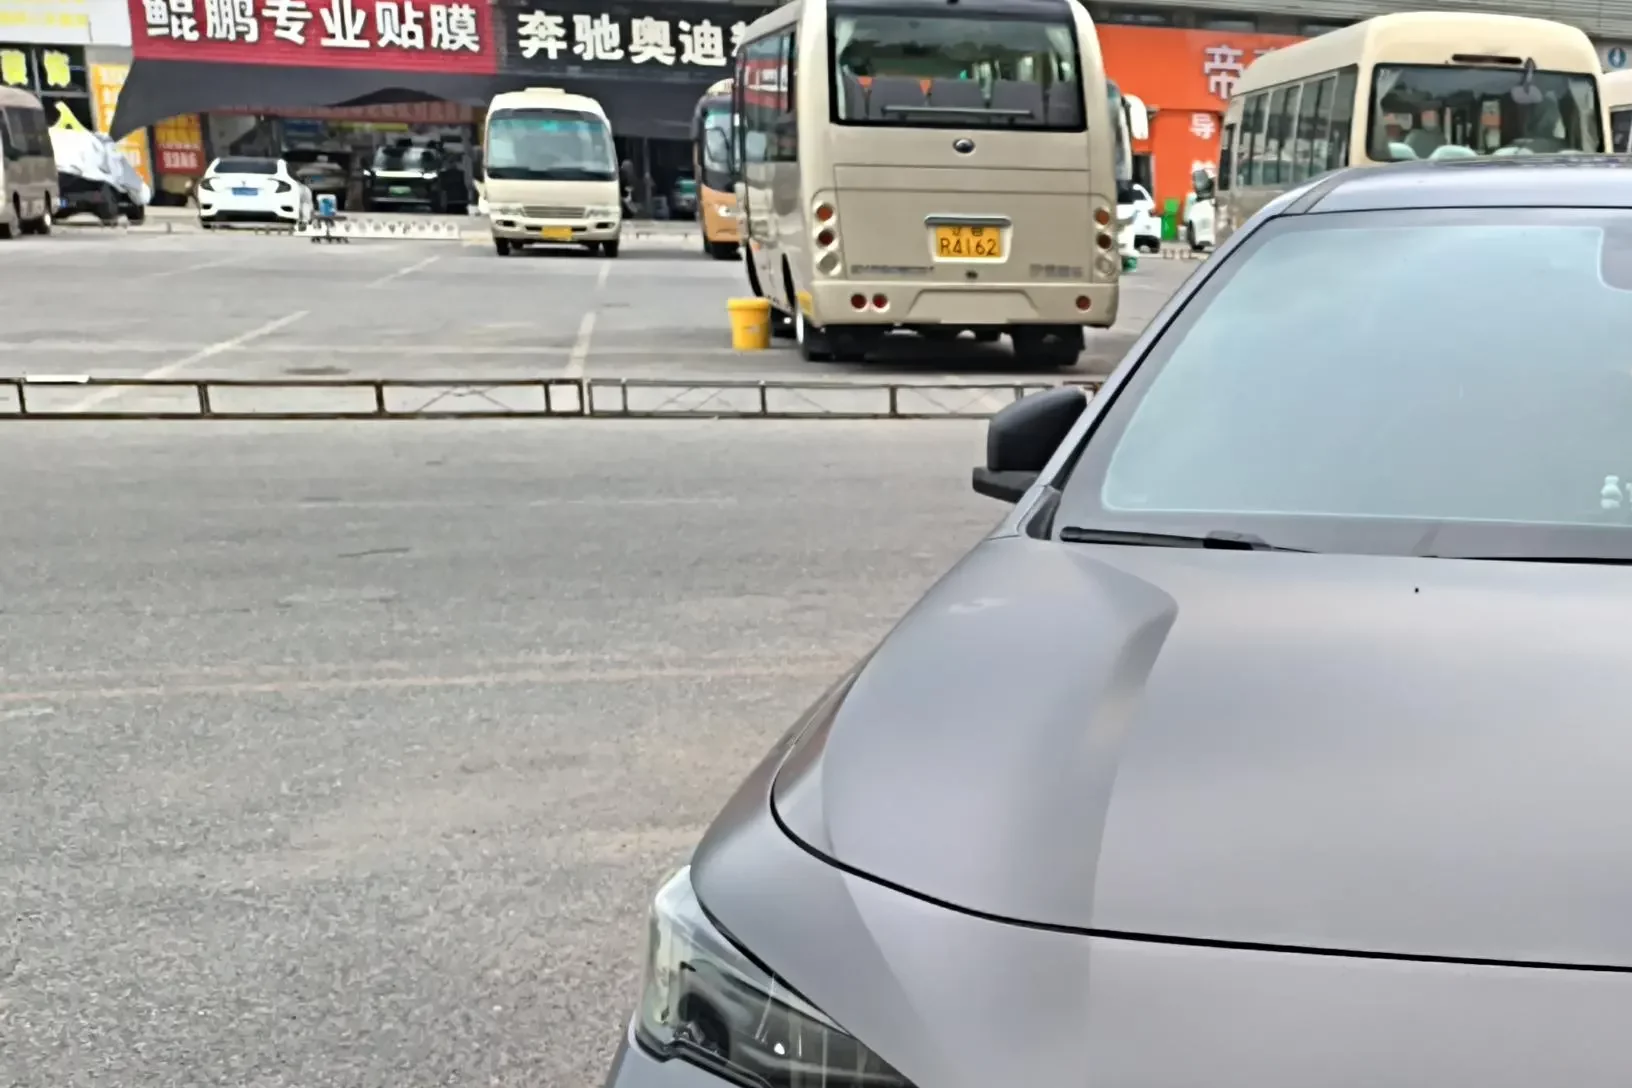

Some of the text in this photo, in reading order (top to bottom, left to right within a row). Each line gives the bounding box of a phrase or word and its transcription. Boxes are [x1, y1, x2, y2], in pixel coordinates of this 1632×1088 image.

[145, 0, 481, 52] 鲲鹏专业贴膜
[939, 237, 998, 256] R4162
